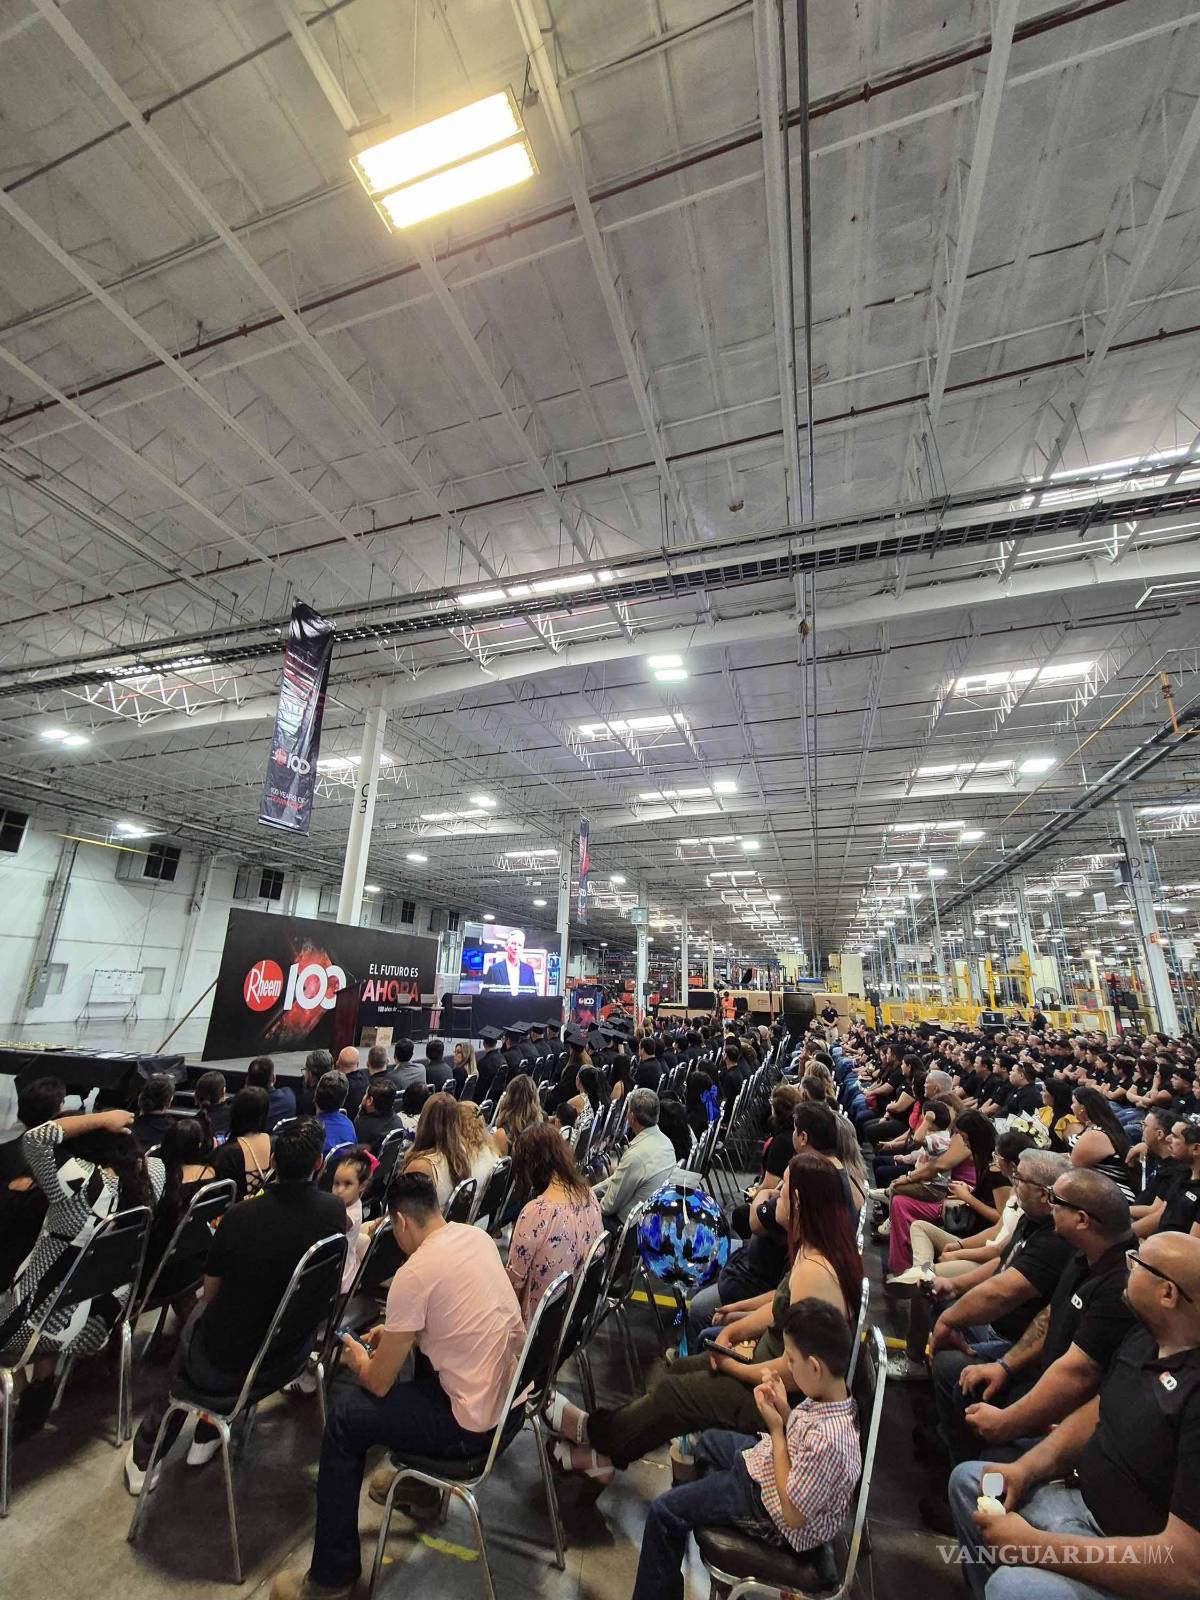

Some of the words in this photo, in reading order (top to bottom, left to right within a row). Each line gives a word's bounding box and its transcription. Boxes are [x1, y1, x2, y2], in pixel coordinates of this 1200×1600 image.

[359, 799, 368, 814] 3
[1133, 870, 1143, 881] 4
[561, 882, 568, 893] 4
[369, 963, 379, 975] EL
[380, 964, 410, 977] FUTURO
[410, 967, 419, 978] ES
[246, 960, 282, 1004] Rheem
